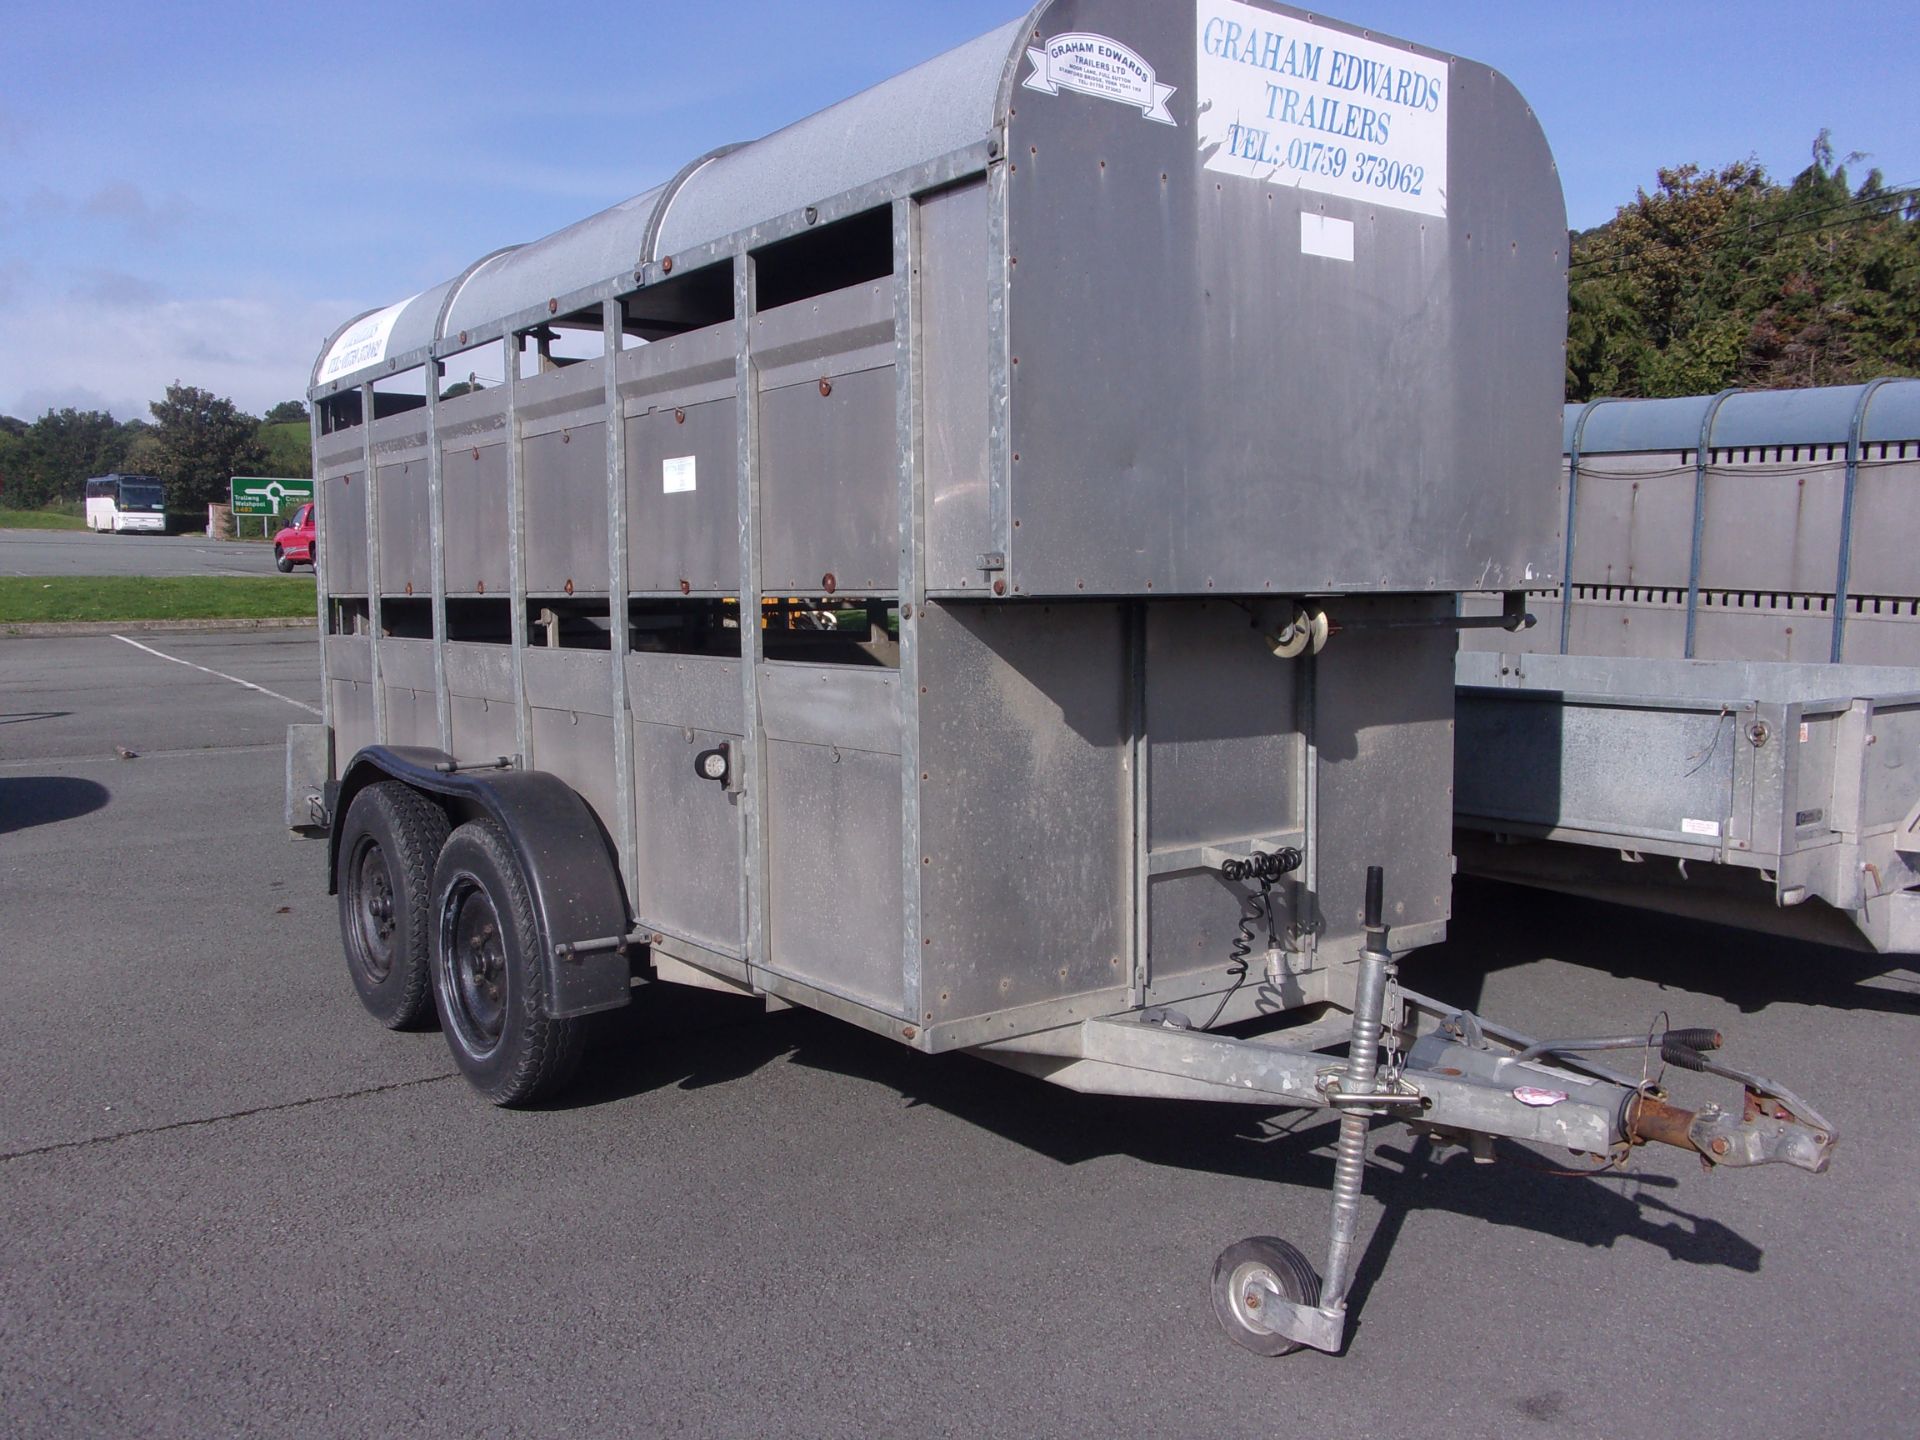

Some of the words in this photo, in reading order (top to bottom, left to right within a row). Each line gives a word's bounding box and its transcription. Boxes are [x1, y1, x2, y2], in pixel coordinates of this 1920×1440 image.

[1051, 42, 1094, 59] GRAHAM
[1098, 45, 1148, 83] EDWARDS
[1075, 55, 1110, 71] TRAILERS
[1111, 65, 1126, 75] LTD
[1203, 16, 1325, 82] GRAHAM
[1327, 50, 1441, 113] EDWARDS
[1265, 80, 1391, 146] TRAILERS
[1227, 123, 1280, 166] TEL:
[1287, 137, 1347, 178] 01759
[1352, 152, 1424, 196] 373062
